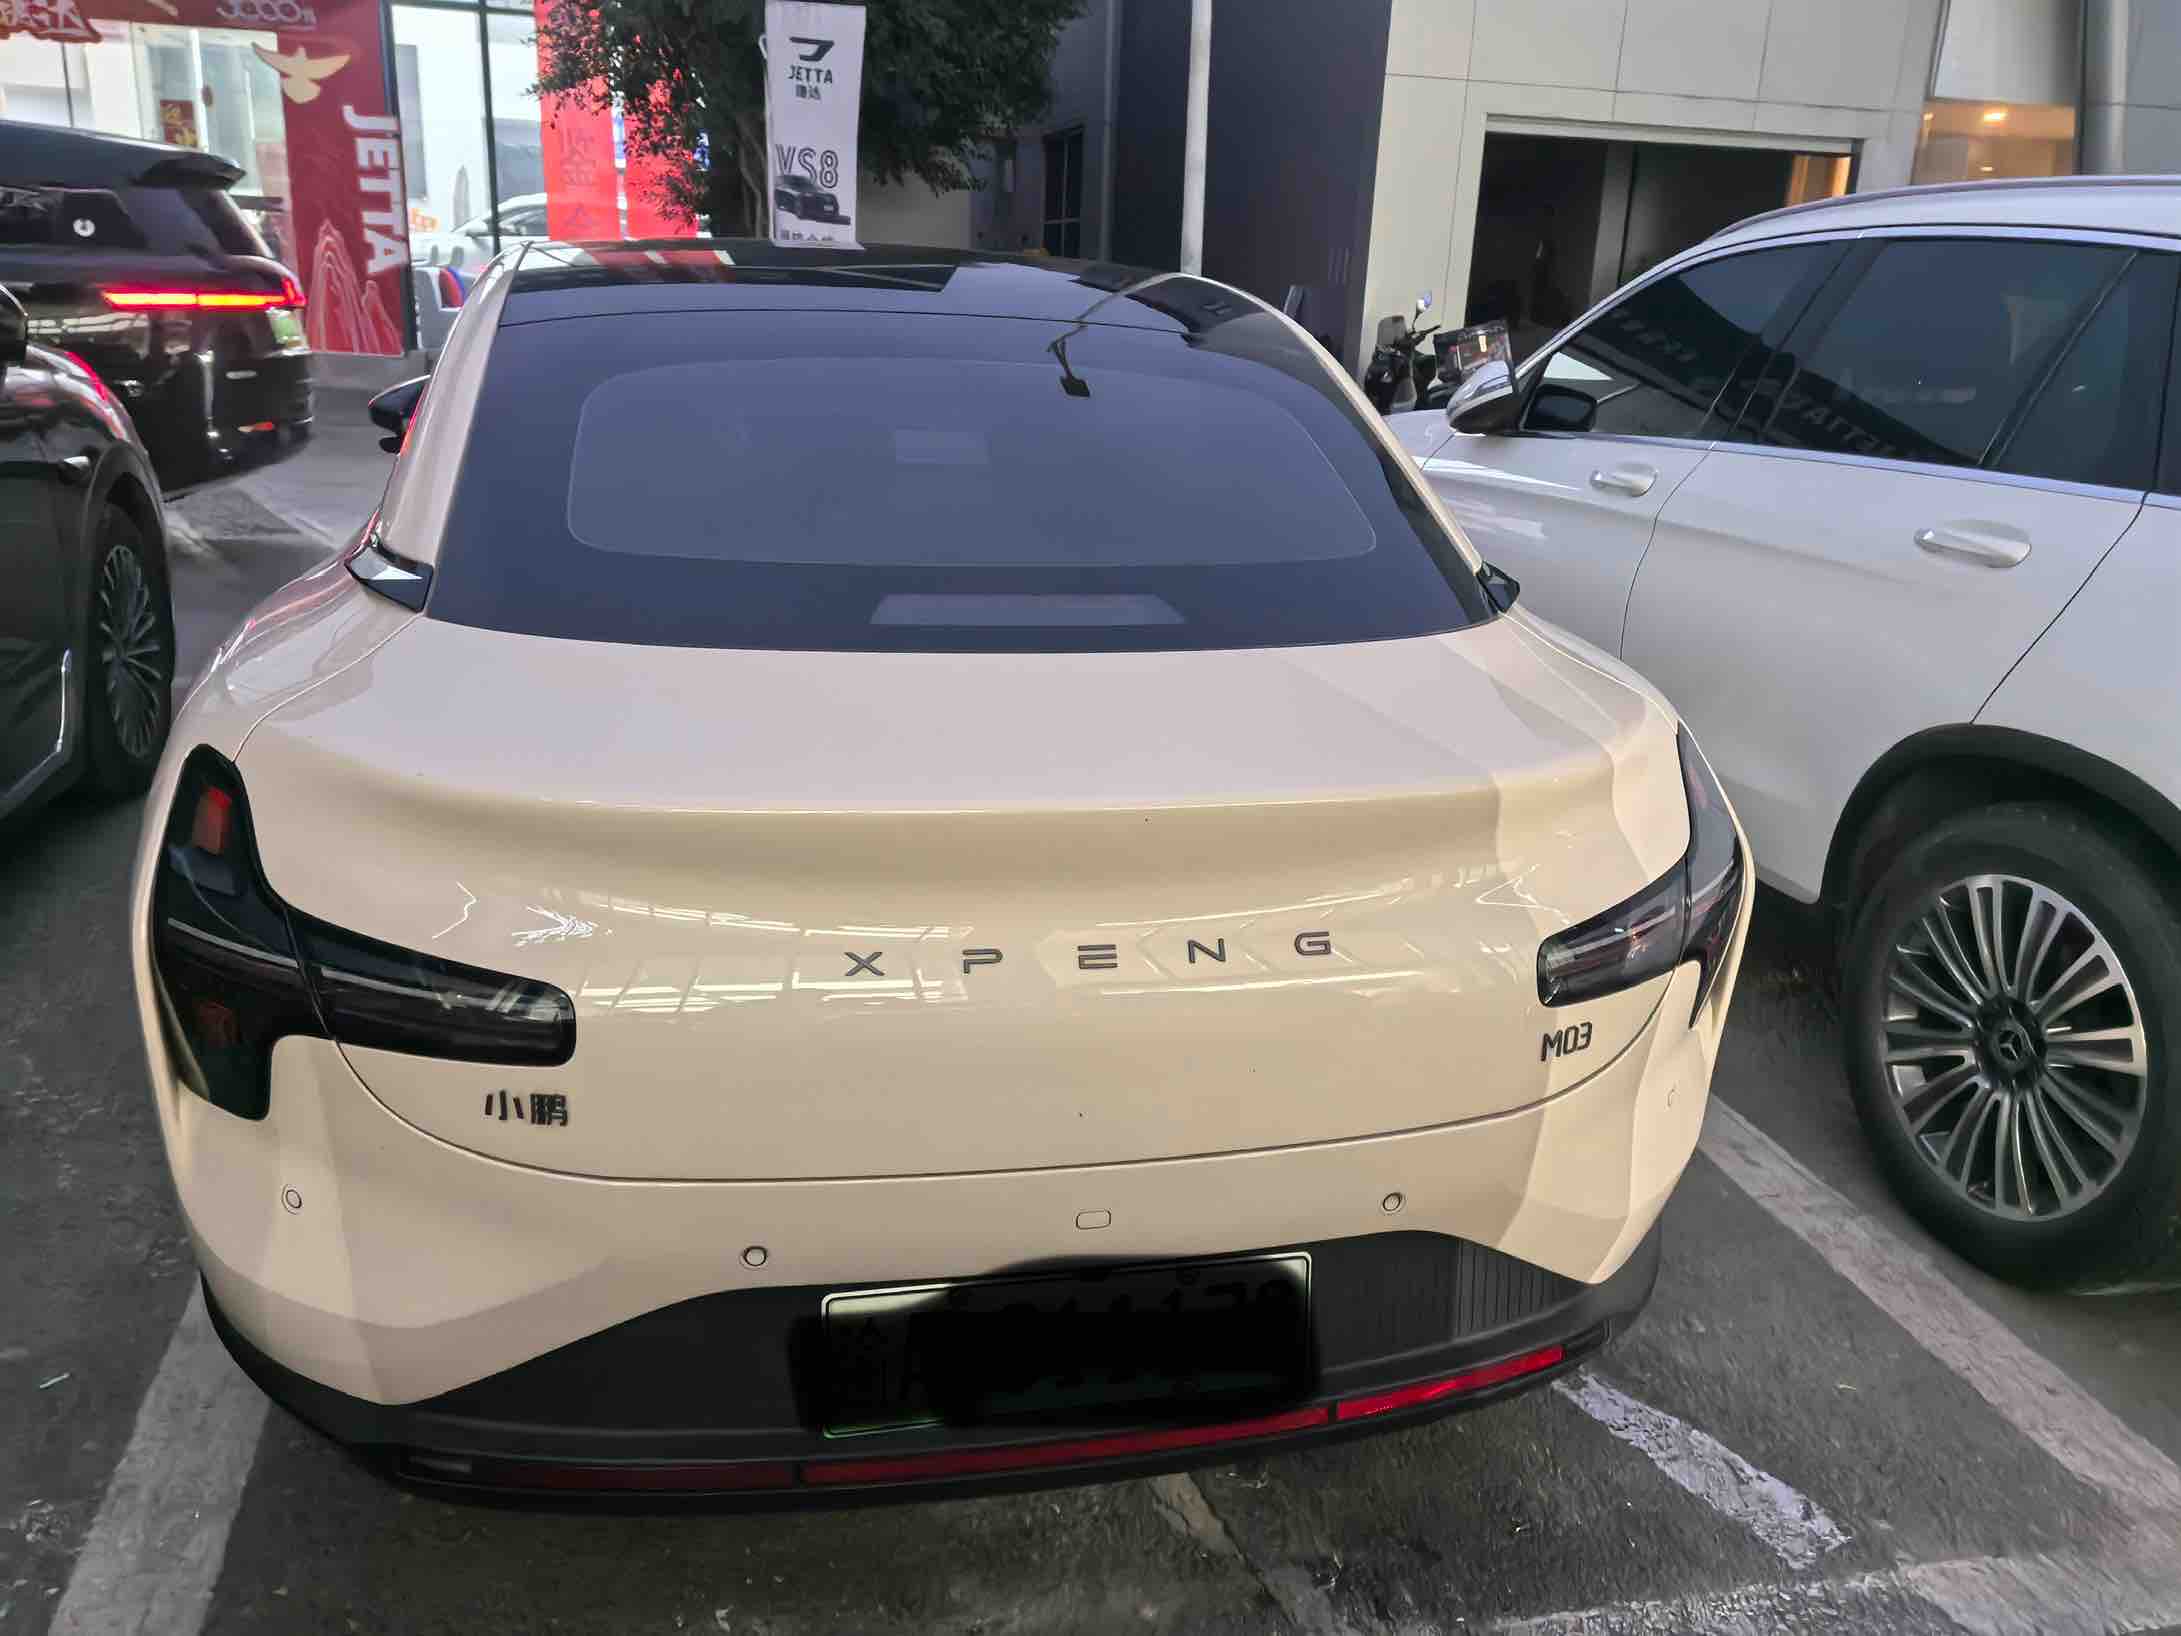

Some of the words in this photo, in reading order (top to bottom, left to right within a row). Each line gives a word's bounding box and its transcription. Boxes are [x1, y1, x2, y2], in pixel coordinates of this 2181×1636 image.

[787, 65, 833, 84] JETTA
[775, 143, 840, 189] VS8
[343, 105, 409, 275] JETTA
[844, 931, 1333, 977] XPENG
[1540, 1021, 1593, 1062] M03
[484, 1090, 568, 1127] 小鹏
